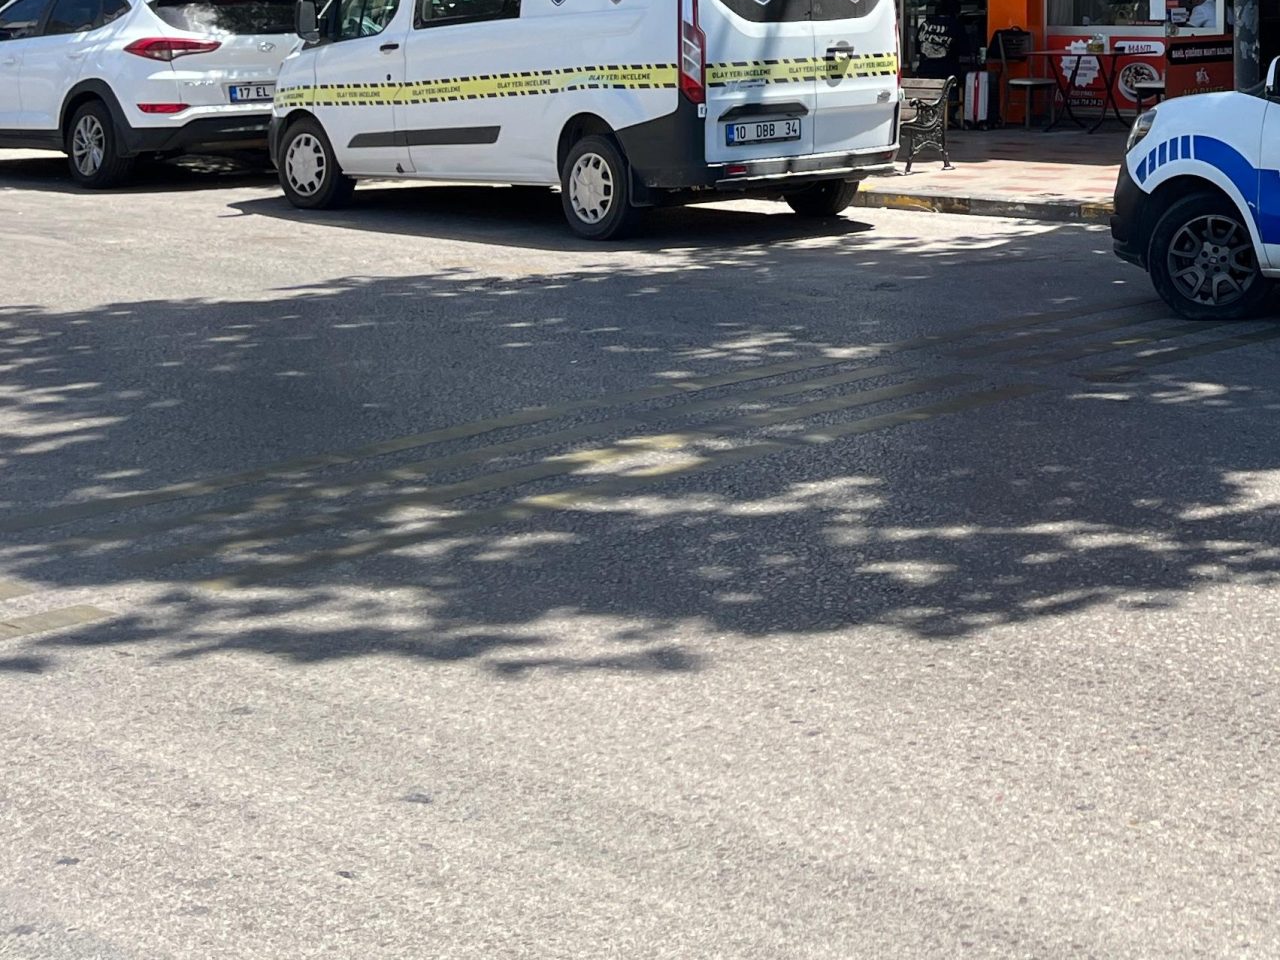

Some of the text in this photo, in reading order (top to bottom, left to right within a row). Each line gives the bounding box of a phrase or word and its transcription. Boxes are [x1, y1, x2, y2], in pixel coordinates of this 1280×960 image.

[239, 87, 251, 99] 17
[735, 121, 797, 139] 10 DBB 34
